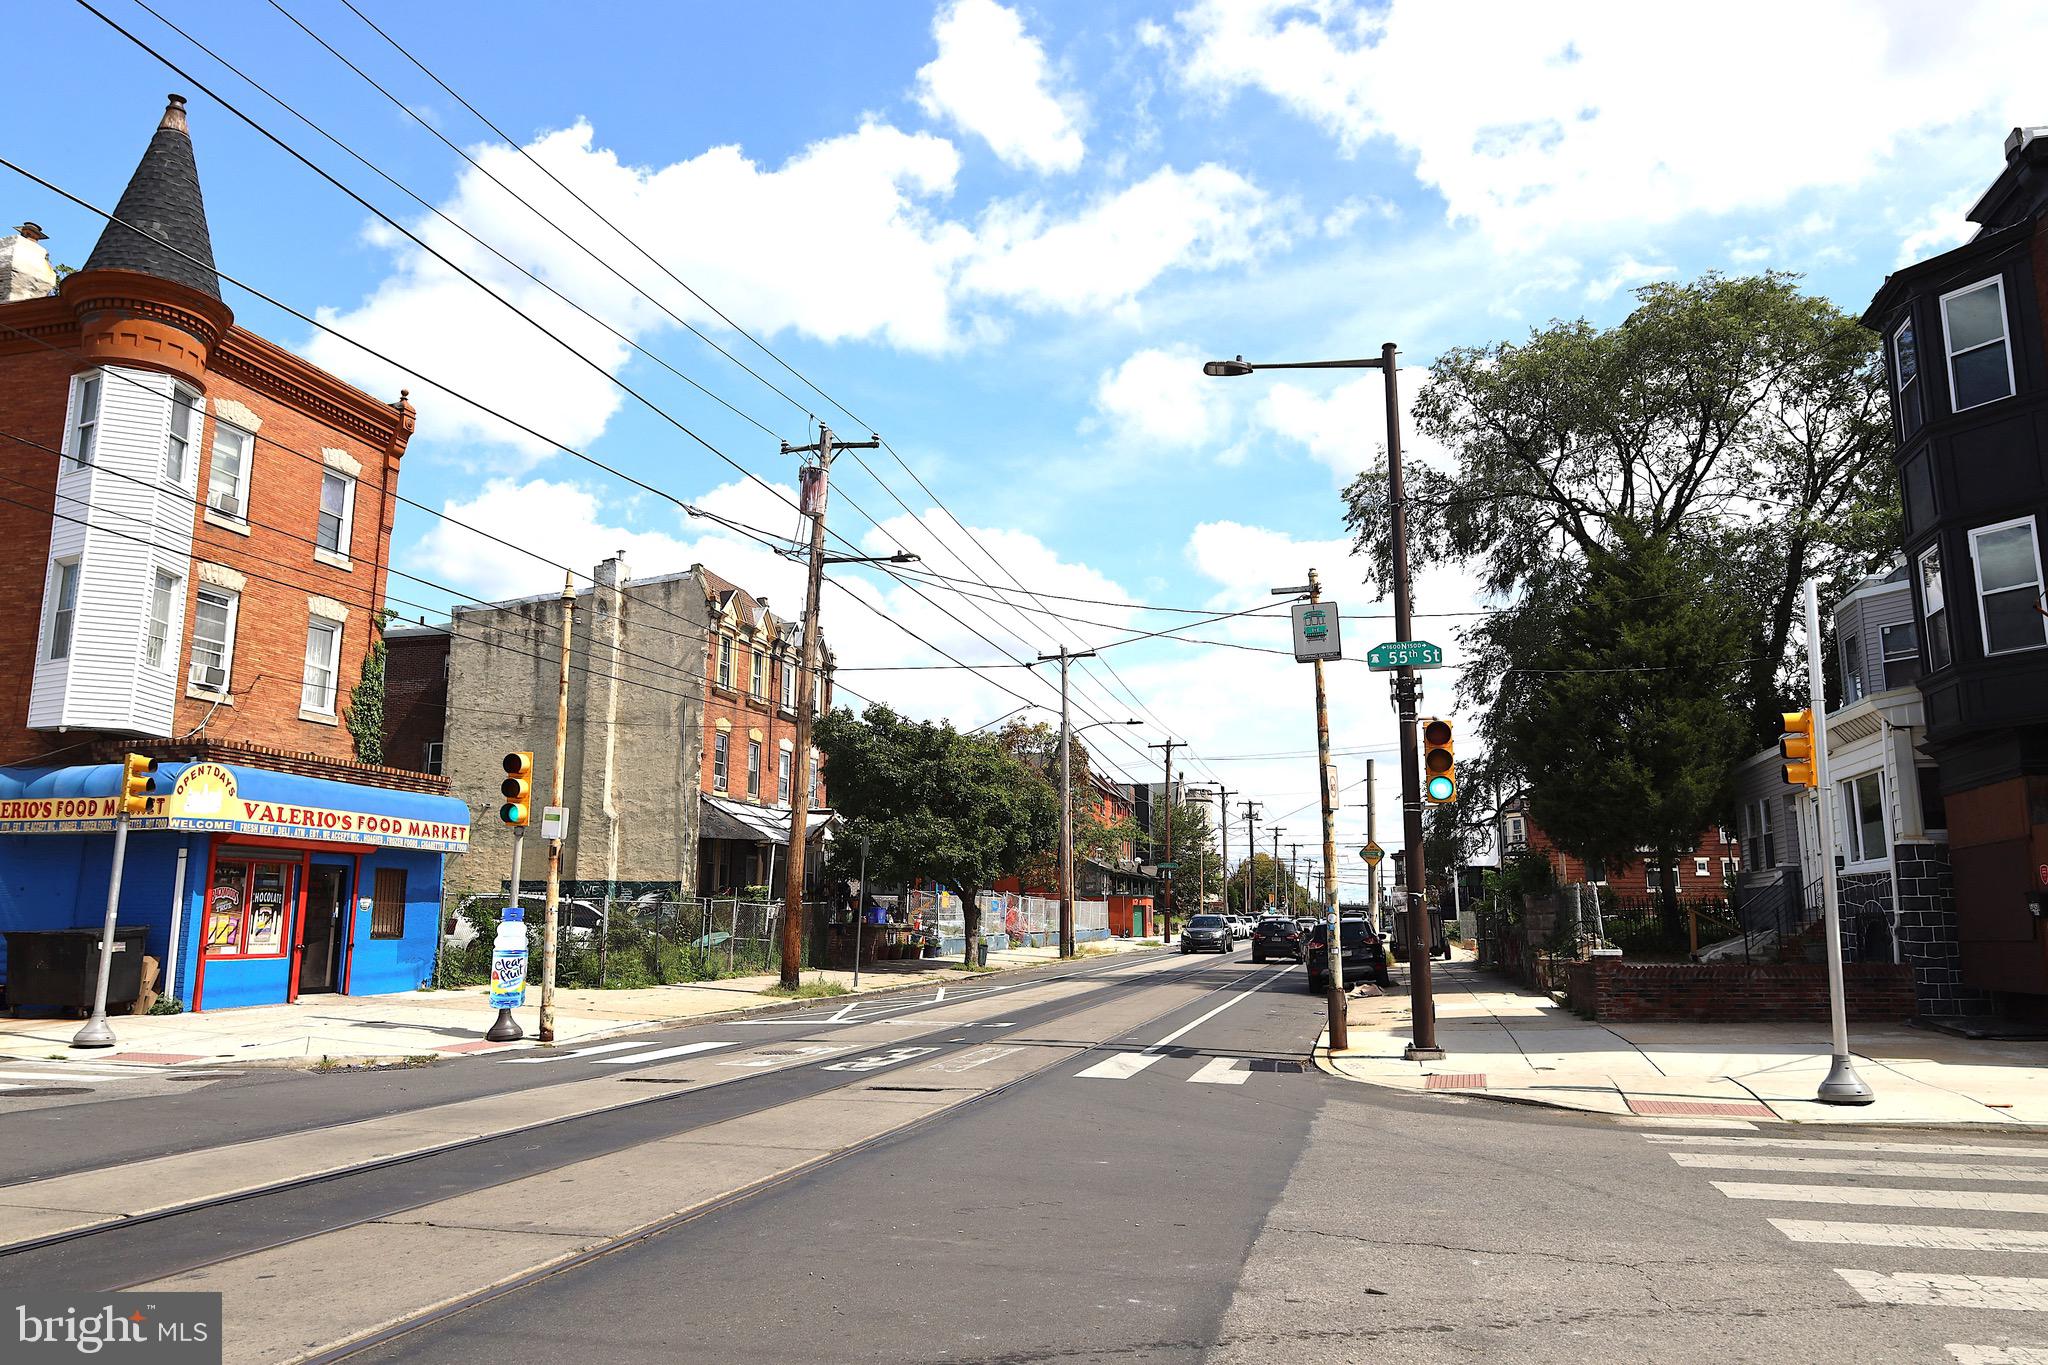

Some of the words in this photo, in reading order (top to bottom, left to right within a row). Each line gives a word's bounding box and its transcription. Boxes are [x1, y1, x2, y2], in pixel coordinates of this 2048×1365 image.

[1389, 649, 1418, 665] 55th
[1423, 649, 1440, 663] St
[176, 765, 205, 795] OPEN
[207, 765, 213, 776] 7
[213, 766, 236, 797] DAYS
[56, 800, 98, 818] FOOD
[169, 819, 233, 830] WELCOME
[243, 802, 352, 830] VALERIO'S
[358, 815, 402, 835] FOOD
[408, 821, 467, 841] MARKET
[240, 823, 259, 833] FRESH
[259, 824, 274, 835] MEAT
[277, 826, 290, 836] DELI
[322, 830, 331, 840] WE
[331, 831, 350, 841] ACCEPT
[582, 885, 600, 896] WE
[500, 964, 525, 982] fruit
